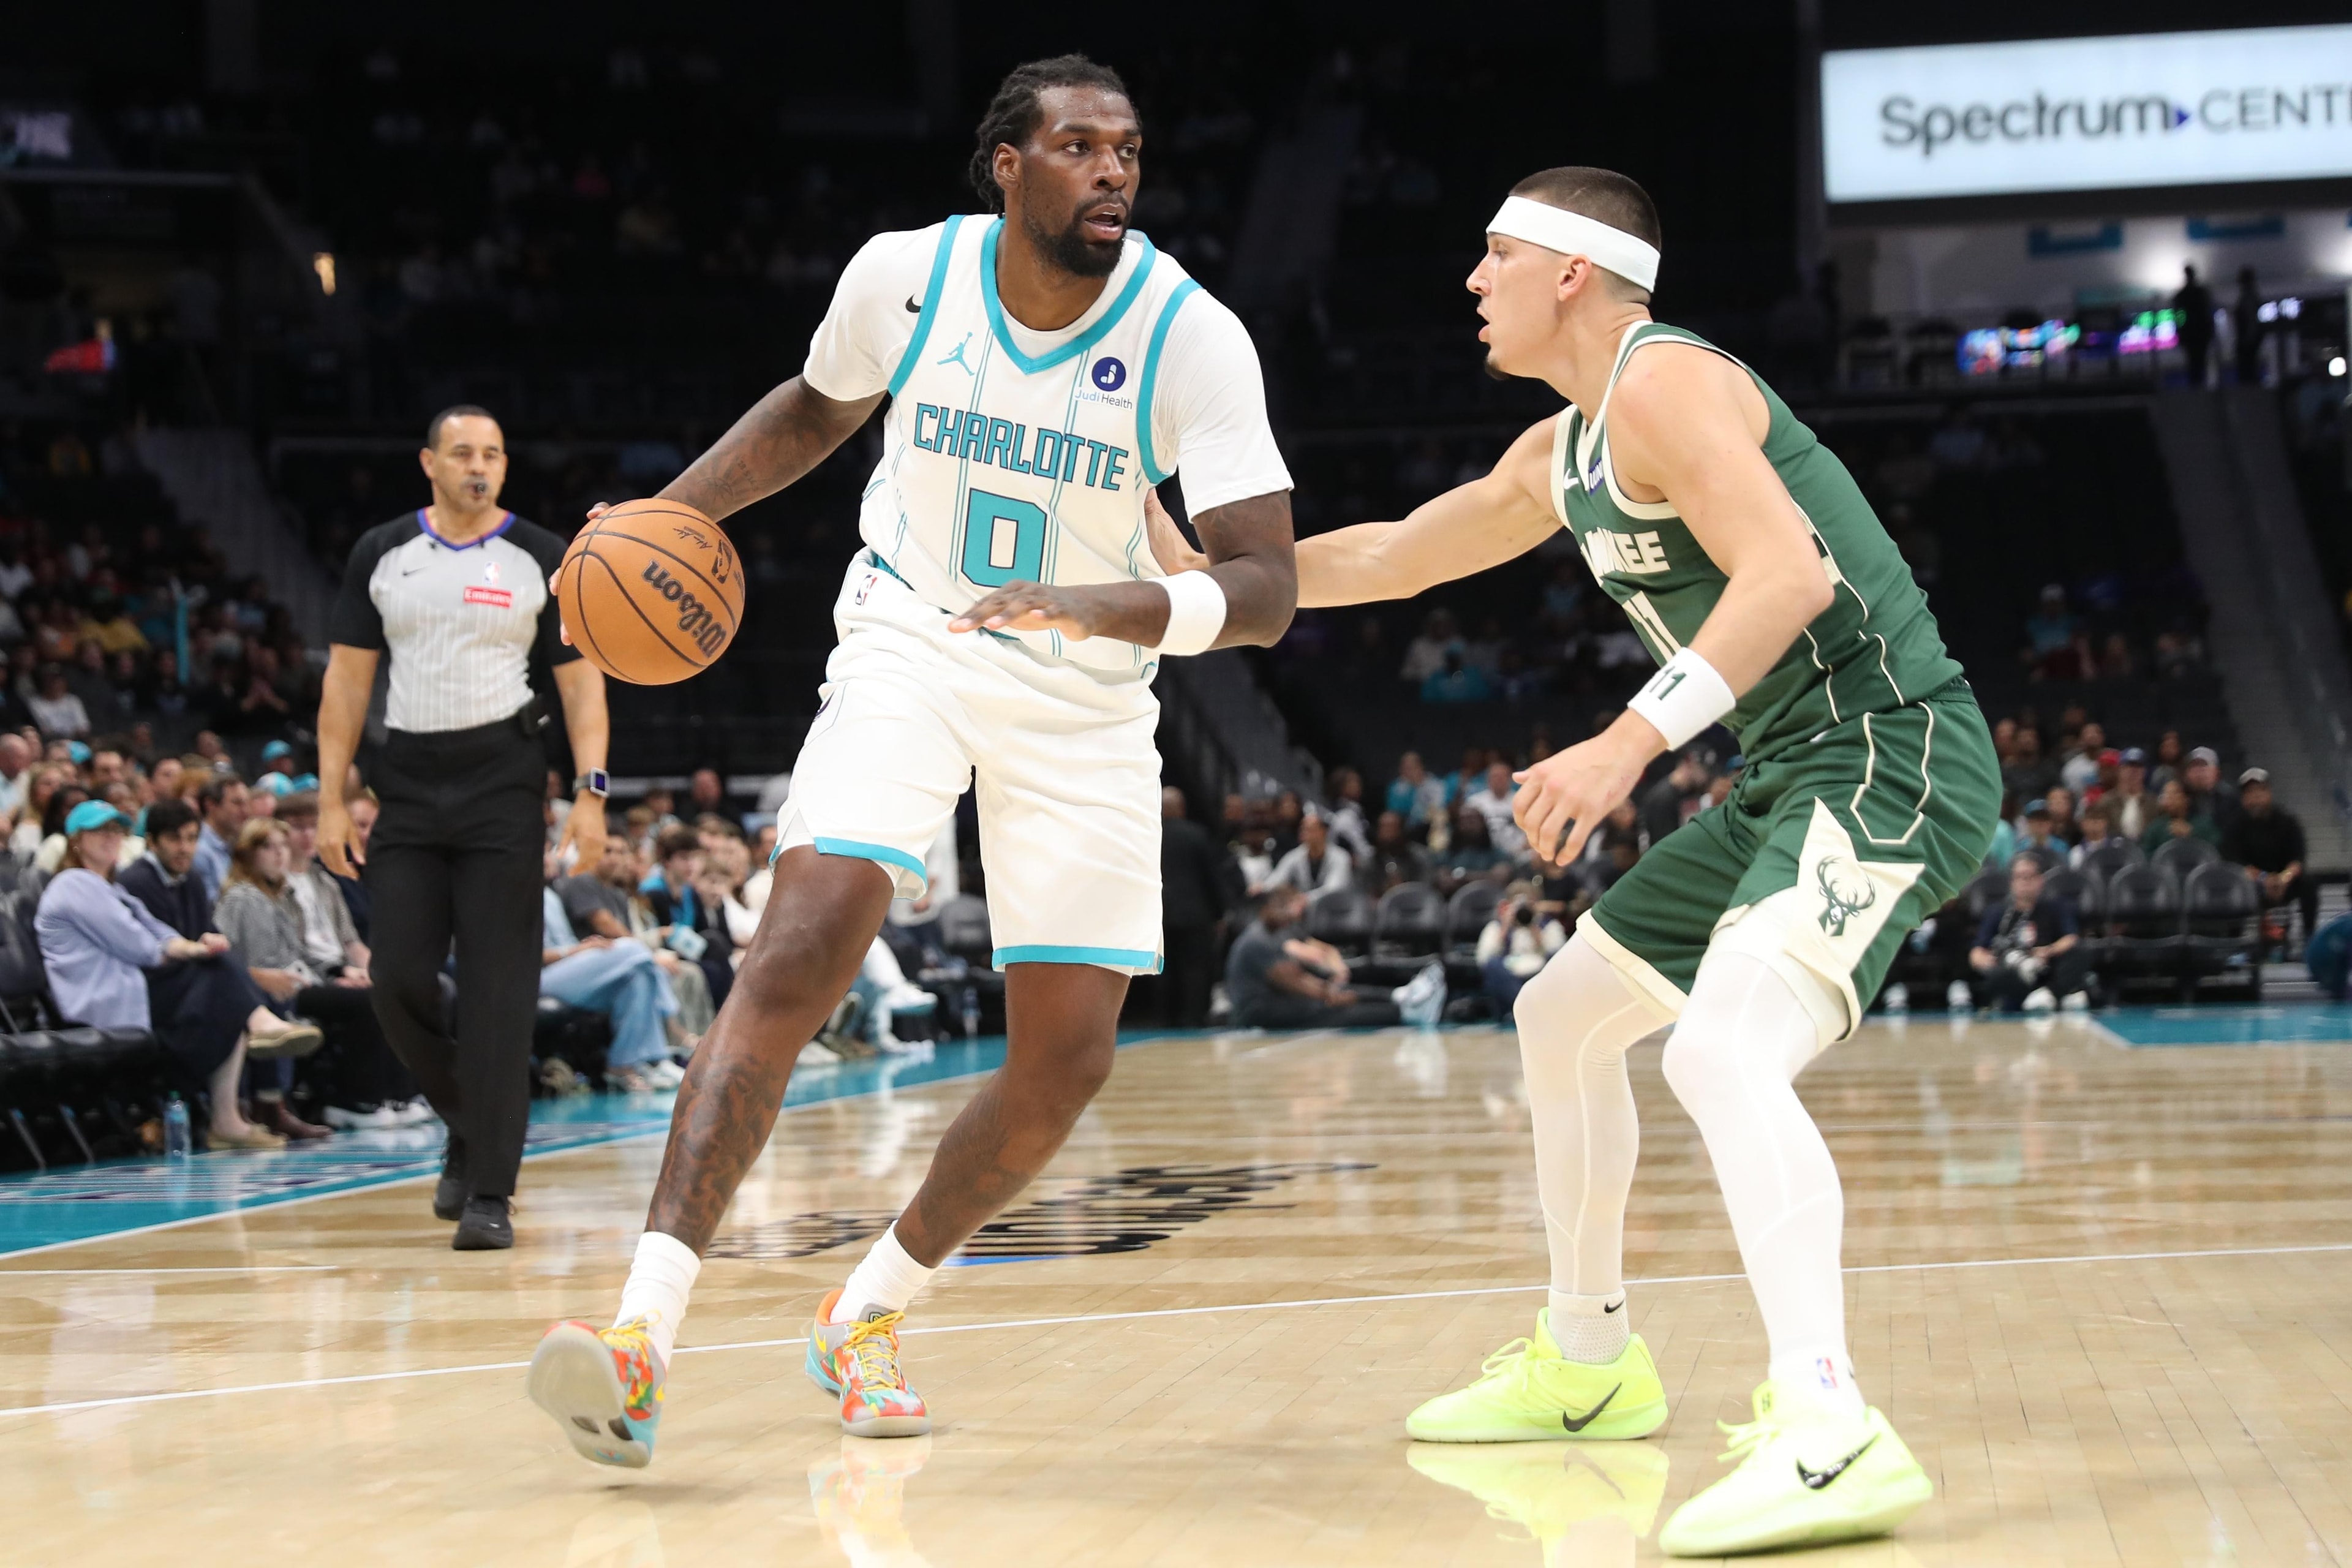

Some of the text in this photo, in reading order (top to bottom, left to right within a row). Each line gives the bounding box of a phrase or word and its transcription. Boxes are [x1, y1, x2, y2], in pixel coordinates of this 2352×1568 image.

[1880, 83, 2352, 156] Spectrum CENT
[1075, 390, 1133, 409] Judi Health
[914, 402, 1129, 491] CHARLOTTE
[961, 488, 1047, 588] 0
[1649, 666, 1687, 701] 11
